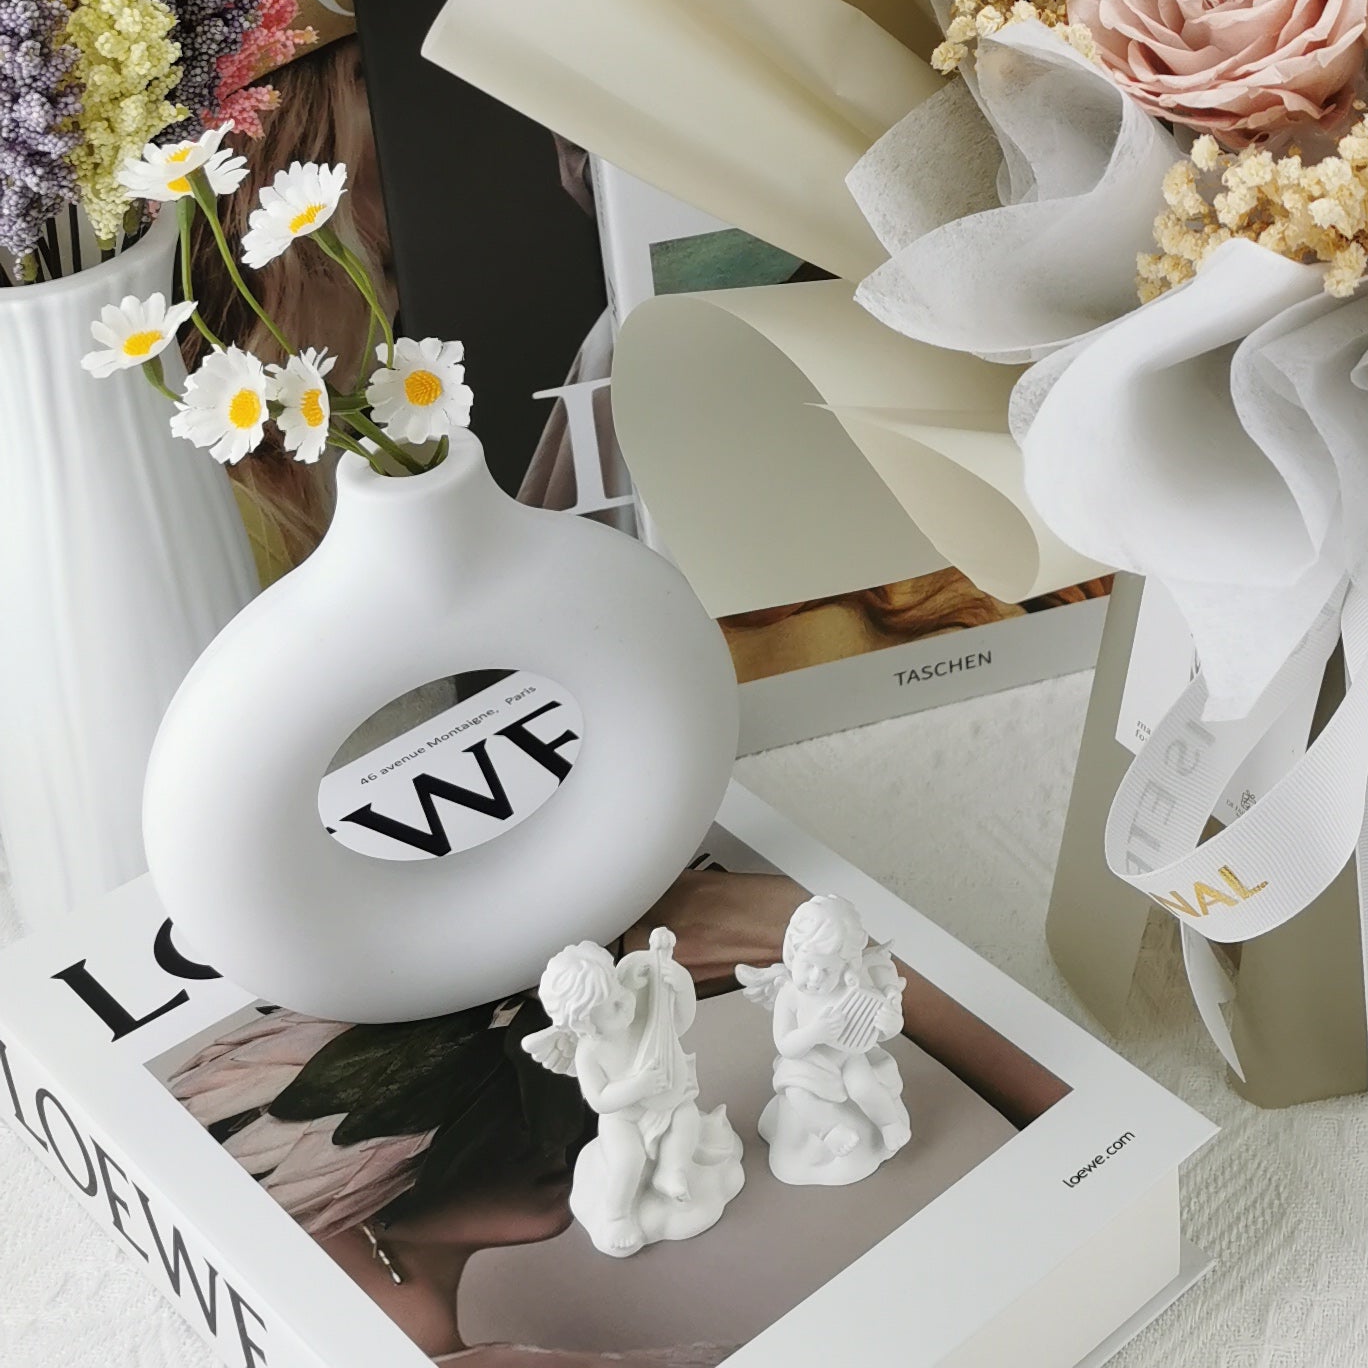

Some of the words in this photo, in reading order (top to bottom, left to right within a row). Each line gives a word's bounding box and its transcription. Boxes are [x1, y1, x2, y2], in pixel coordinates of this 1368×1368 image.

[893, 650, 992, 687] TASCHEN
[360, 772, 379, 786] 46
[379, 744, 427, 776] avenue
[425, 707, 501, 750] Montaigne,
[503, 684, 538, 706] Paris
[1061, 1130, 1137, 1189] loewe.com
